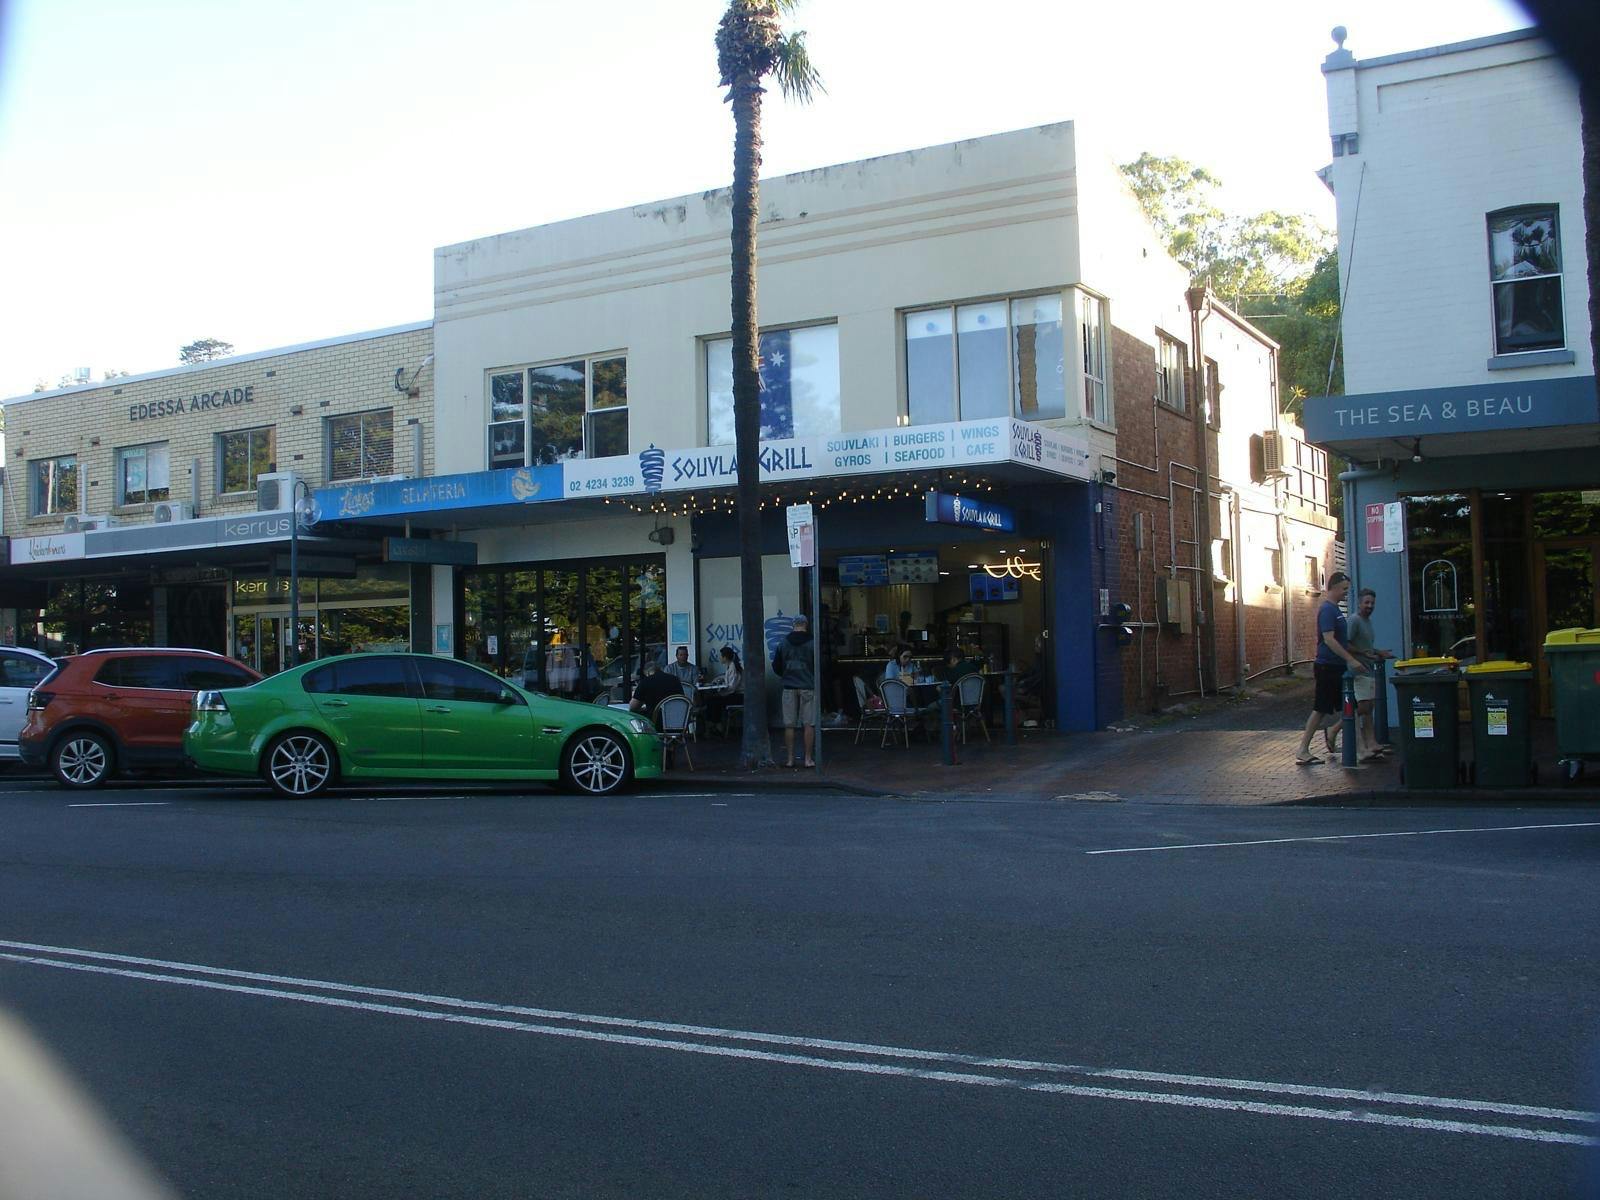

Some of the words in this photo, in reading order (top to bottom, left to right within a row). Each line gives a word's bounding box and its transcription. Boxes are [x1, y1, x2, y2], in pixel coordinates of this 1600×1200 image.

[129, 397, 185, 421] EDESSA
[190, 386, 254, 412] ARCADE
[1334, 407, 1379, 426] THE
[1388, 404, 1432, 423] SEA
[1441, 401, 1456, 419] &
[1467, 395, 1532, 417] BEAU
[827, 436, 879, 453] SOUVLAKI
[893, 430, 945, 447] BURGERS
[960, 425, 1000, 440] WINGS
[758, 446, 813, 473] GRILL
[834, 454, 872, 468] GYROS
[894, 447, 945, 462] SEAFOOD
[966, 442, 995, 457] CAFE
[569, 480, 581, 492] 02
[585, 478, 608, 491] 4234
[611, 476, 635, 489] 3239
[224, 518, 290, 537] kerrys
[706, 623, 744, 643] SOUV
